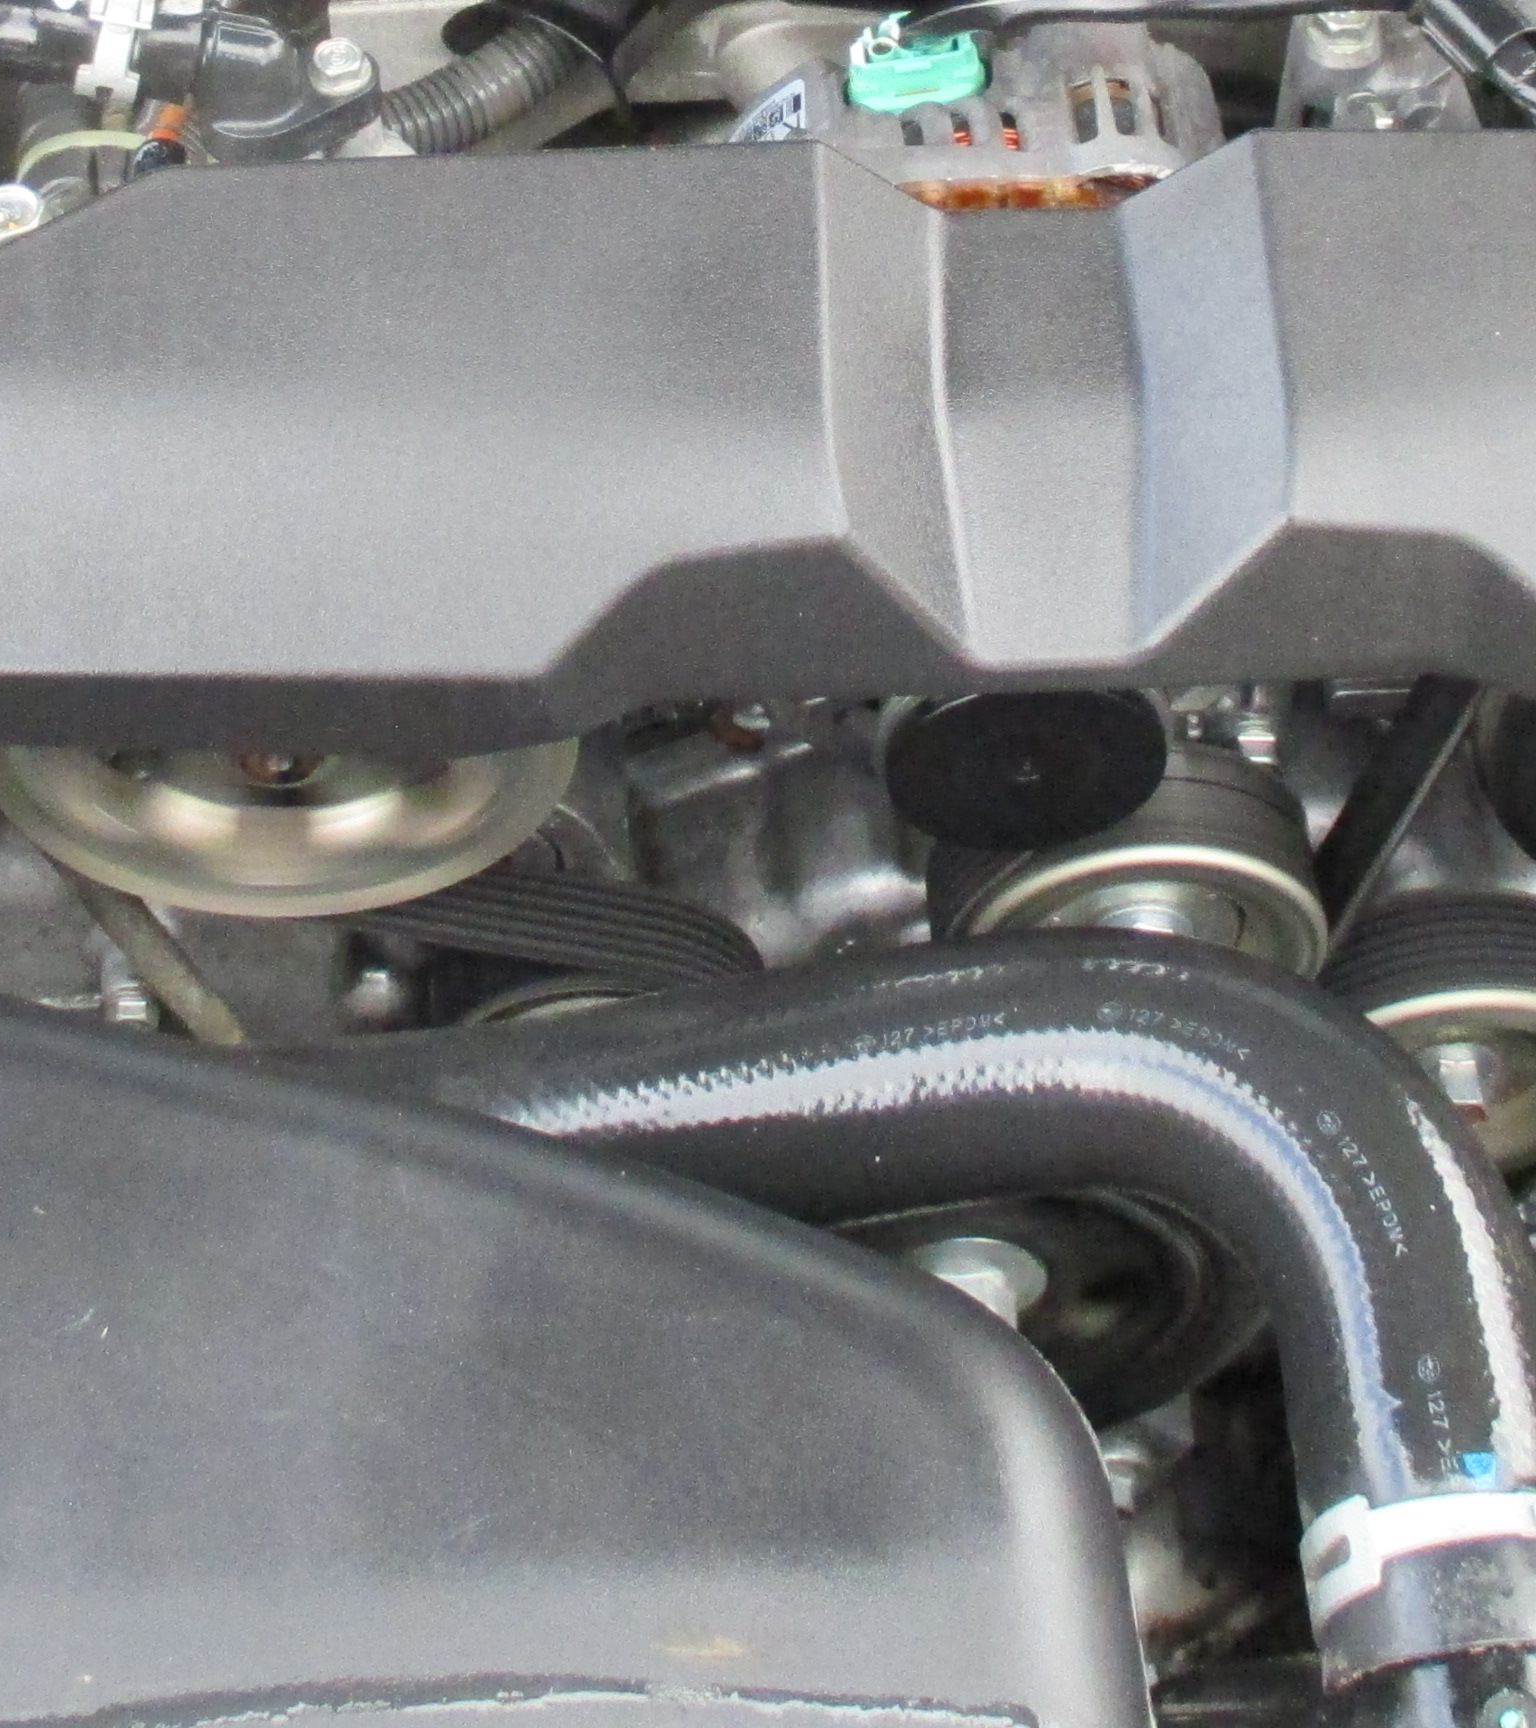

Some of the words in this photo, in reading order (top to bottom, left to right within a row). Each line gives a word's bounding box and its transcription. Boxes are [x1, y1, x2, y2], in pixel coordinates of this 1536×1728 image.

[1129, 1007, 1166, 1026] 127
[882, 1026, 915, 1047] 127
[1426, 1391, 1449, 1429] 127
